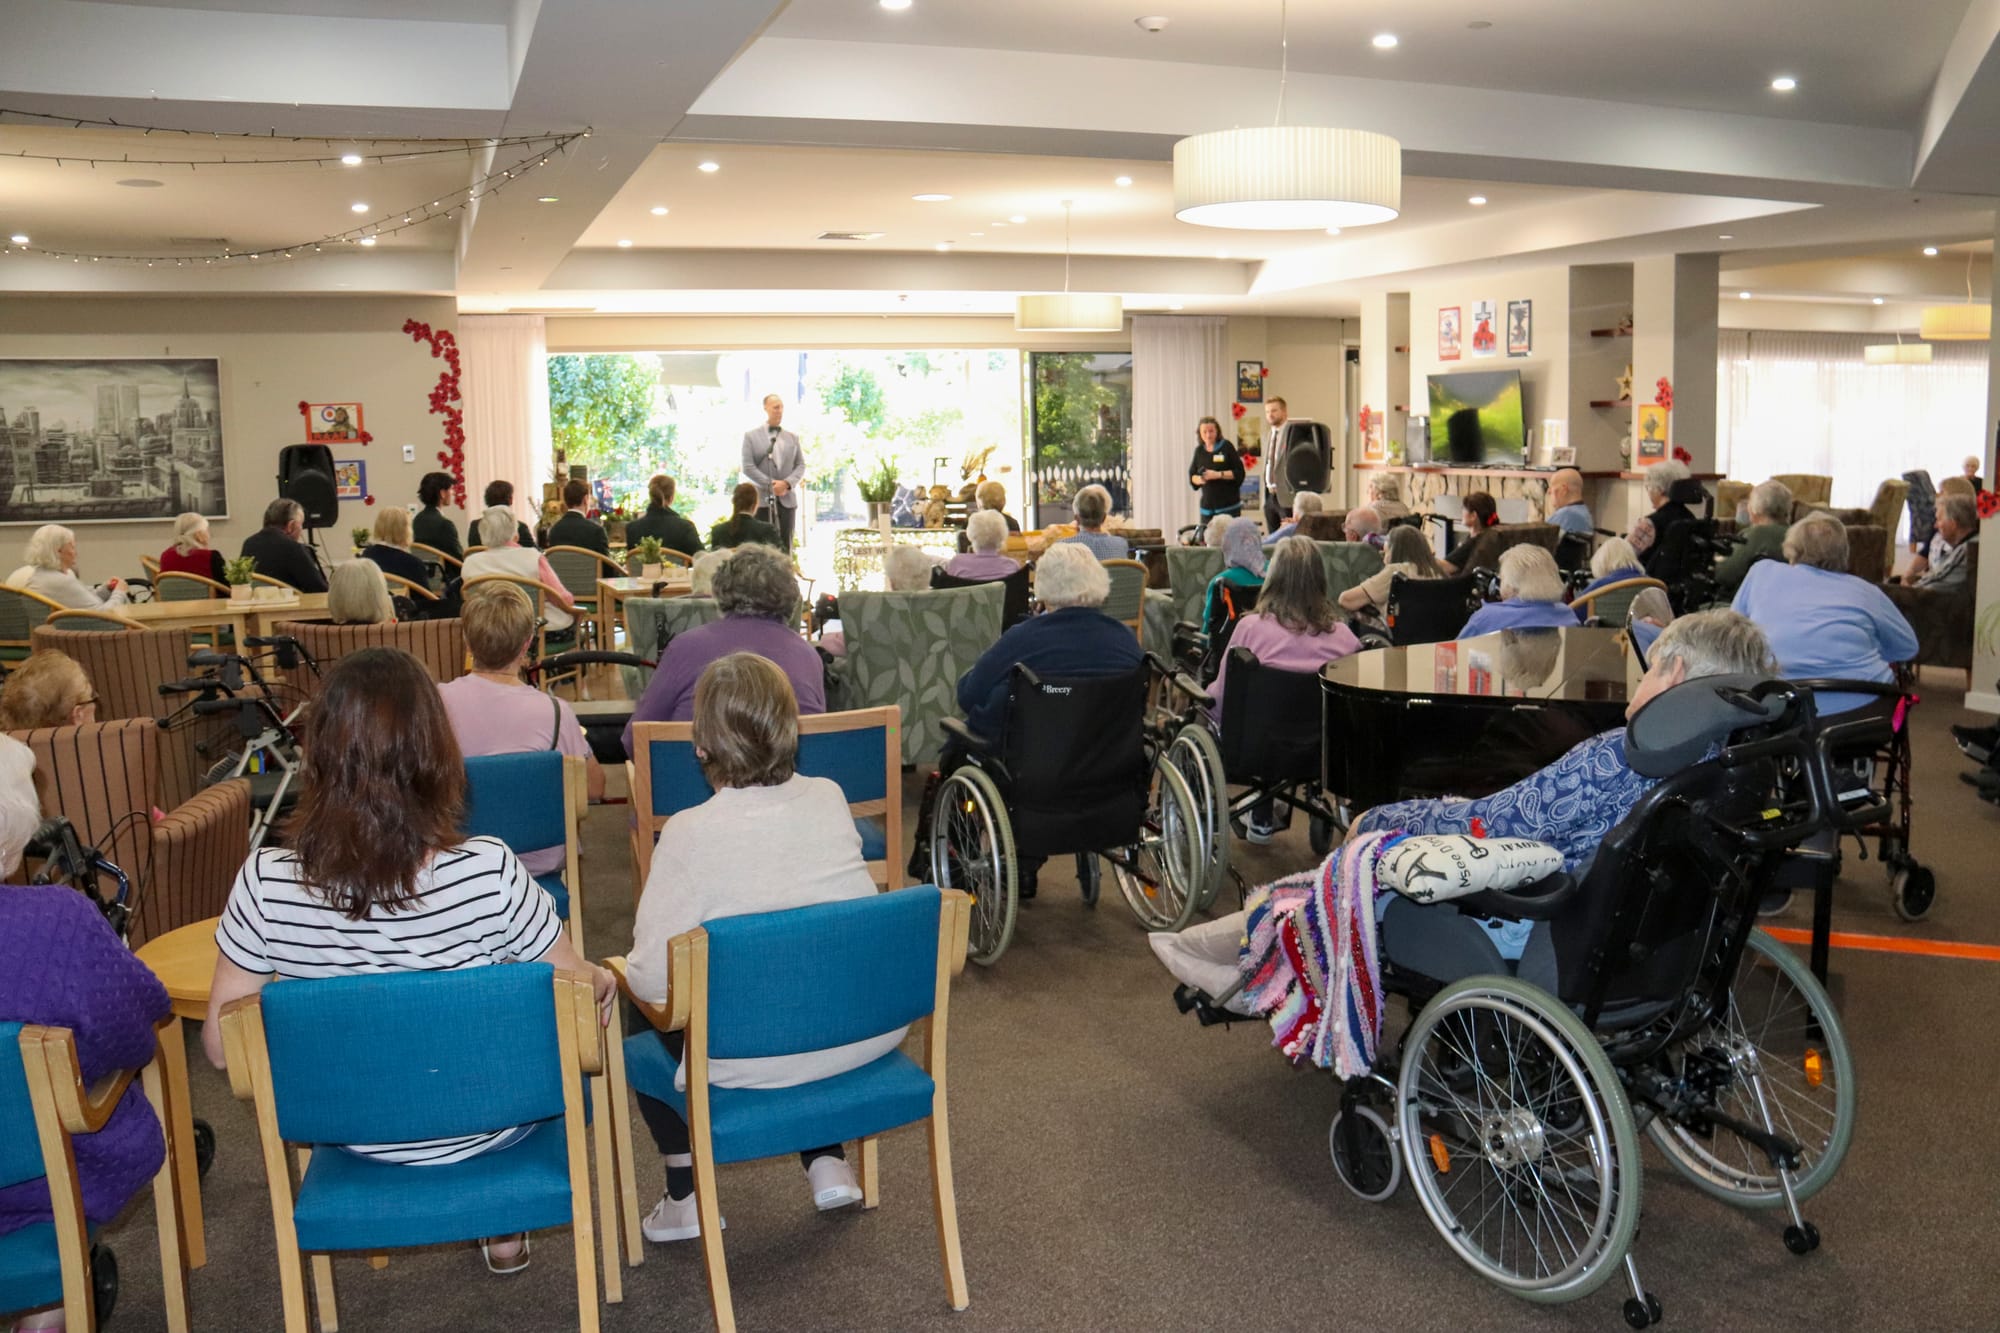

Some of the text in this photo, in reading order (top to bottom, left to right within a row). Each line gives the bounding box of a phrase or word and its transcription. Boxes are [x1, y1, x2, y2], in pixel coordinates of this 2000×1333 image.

[853, 546, 888, 556] LEST WE
[1046, 684, 1072, 696] Breezy
